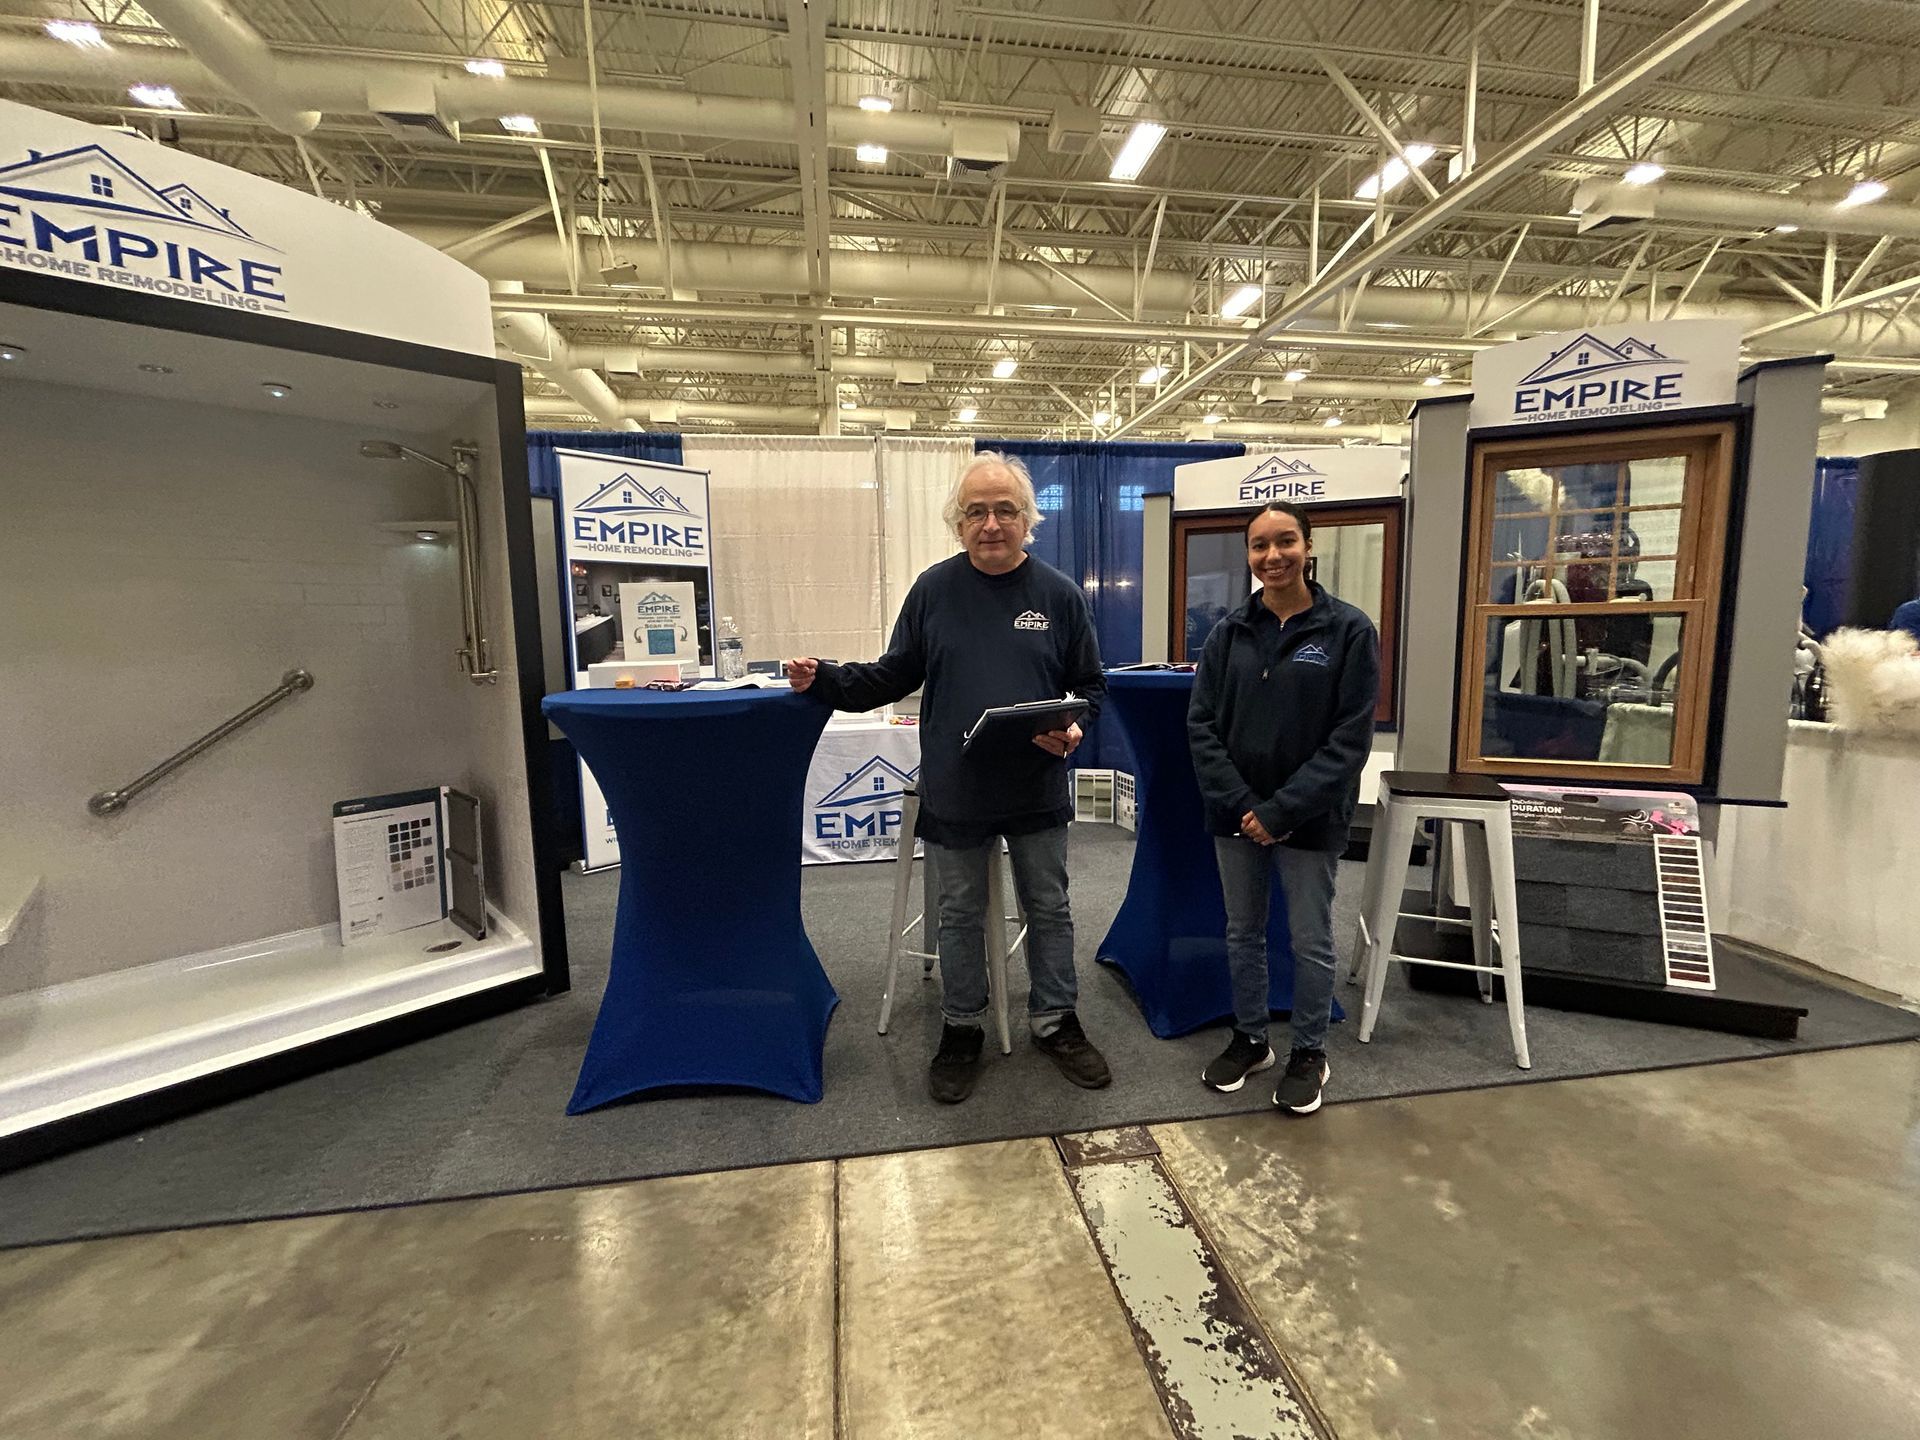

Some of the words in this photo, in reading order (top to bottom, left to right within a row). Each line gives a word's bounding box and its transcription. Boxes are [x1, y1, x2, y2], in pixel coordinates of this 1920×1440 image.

[3, 247, 91, 279] HOME
[97, 266, 263, 312] REMODELING
[1514, 372, 1683, 414] EMPIRE
[1527, 410, 1568, 423] HOME
[1569, 401, 1663, 419] REMODELING
[1239, 480, 1326, 500] EMPIRE
[573, 516, 704, 549] EMPIRE
[588, 543, 622, 553] HOME
[624, 546, 692, 557] REMODELING
[637, 605, 680, 613] EMPIRE
[1014, 620, 1050, 628] EMPIRE
[815, 810, 902, 839] EMP
[831, 839, 870, 850] HOME
